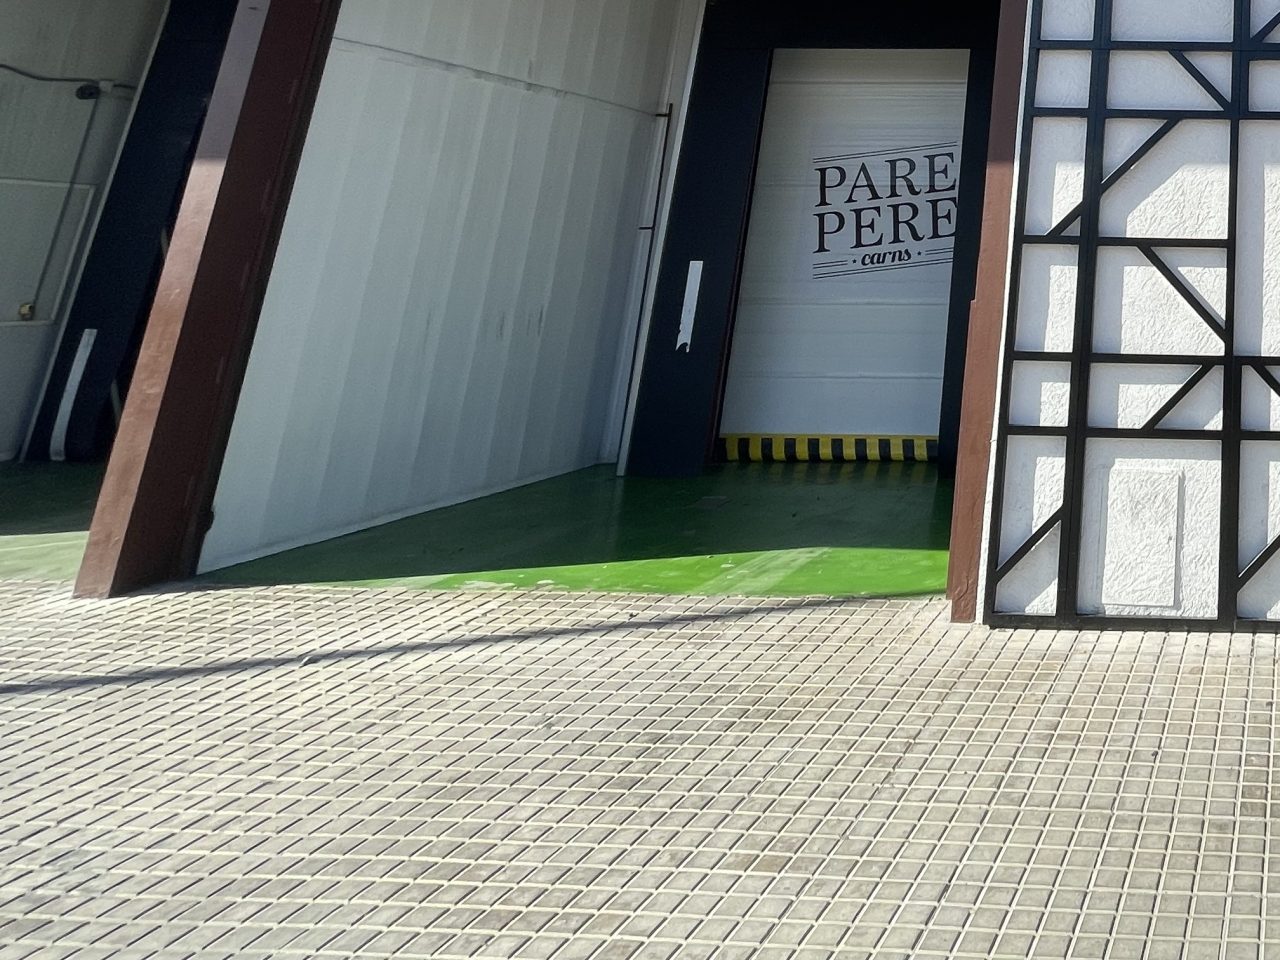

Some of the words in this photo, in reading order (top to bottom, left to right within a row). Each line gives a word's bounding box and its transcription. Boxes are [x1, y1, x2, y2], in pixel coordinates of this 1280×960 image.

[814, 152, 957, 208] PARE
[812, 197, 958, 254] PERE
[860, 248, 912, 266] carns
